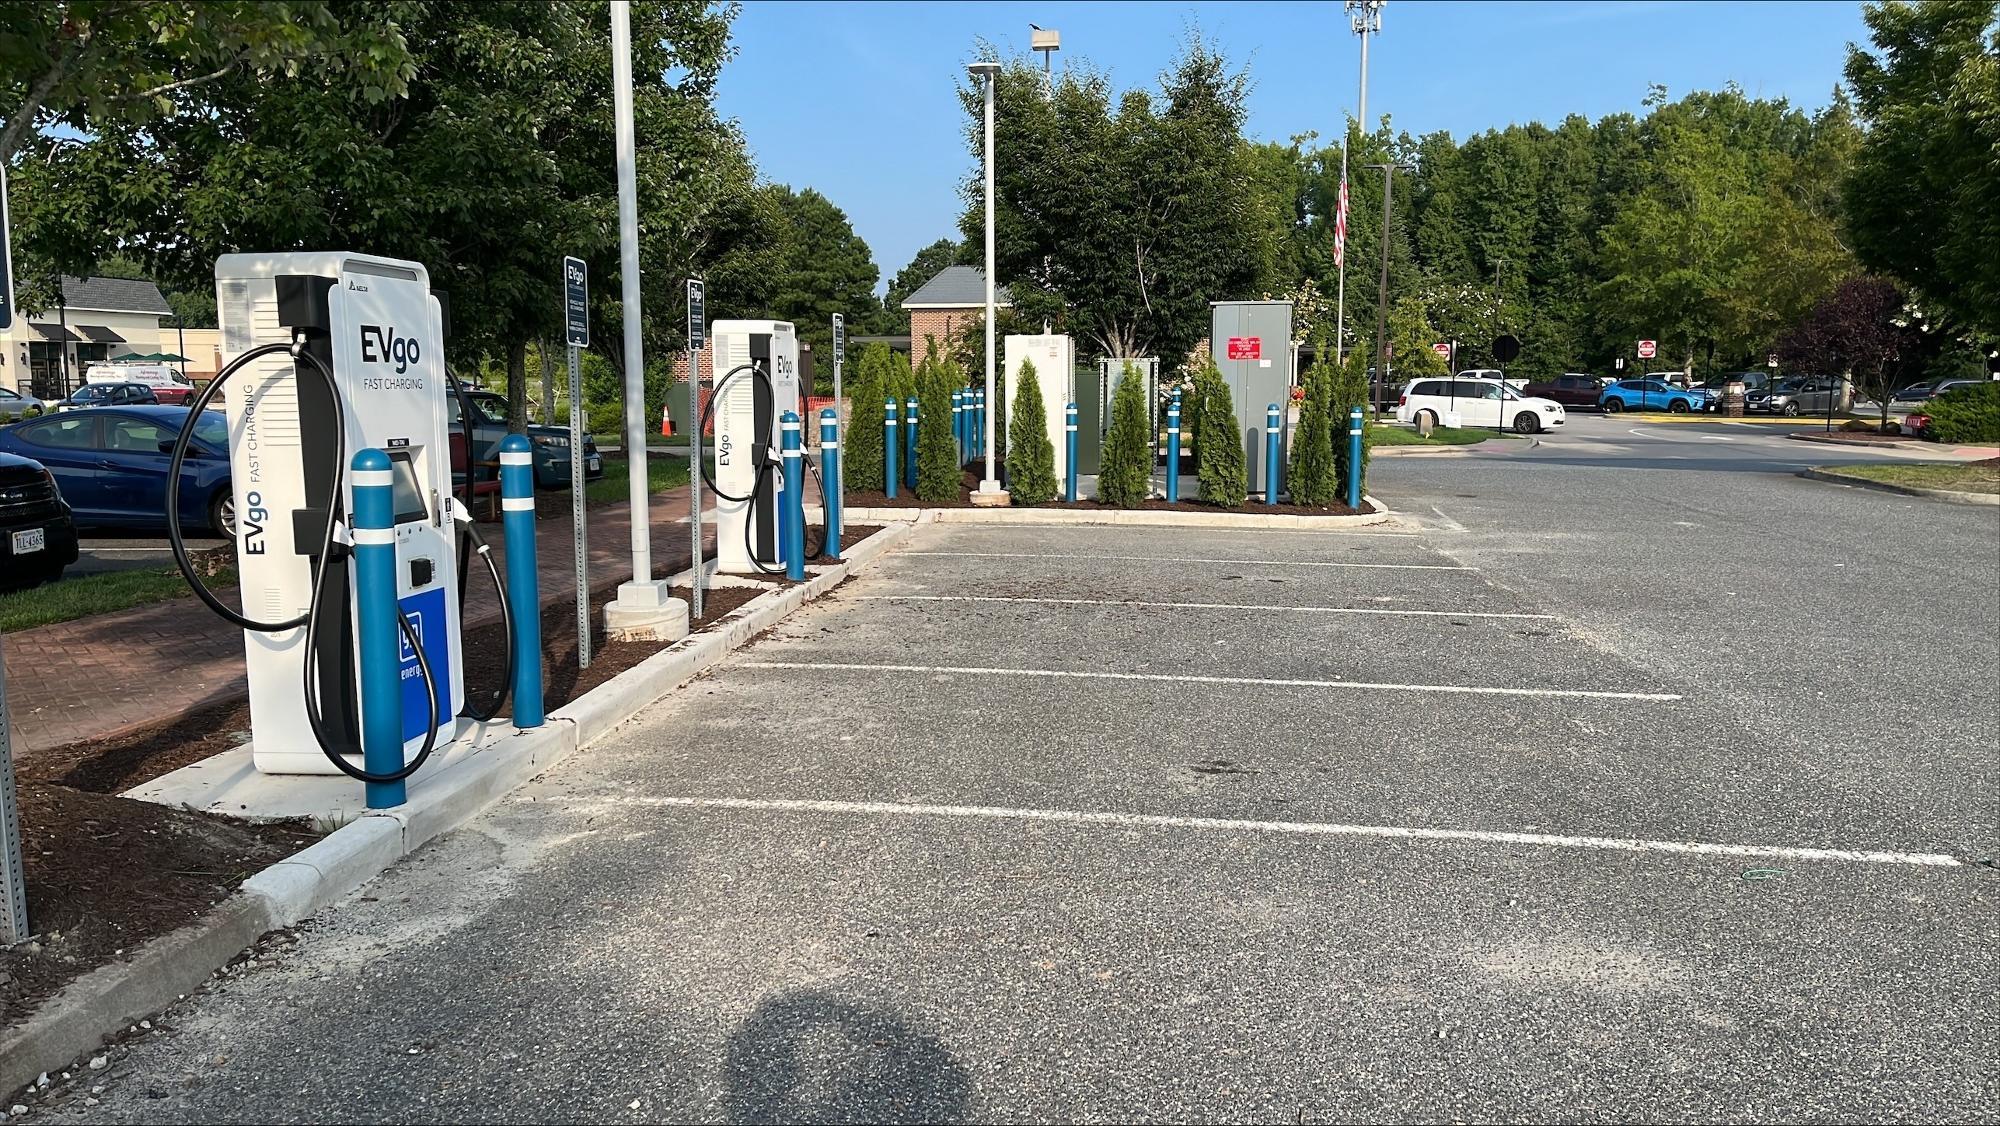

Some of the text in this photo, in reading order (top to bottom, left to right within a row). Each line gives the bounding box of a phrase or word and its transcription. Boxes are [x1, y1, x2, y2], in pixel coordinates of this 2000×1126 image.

[568, 265, 584, 284] EVgo
[360, 325, 420, 374] EVgo
[778, 355, 793, 379] EVgo
[364, 378, 423, 390] FAST CHARGING
[719, 434, 732, 466] EVgo
[243, 384, 269, 555] EVgo FAST CHARGING
